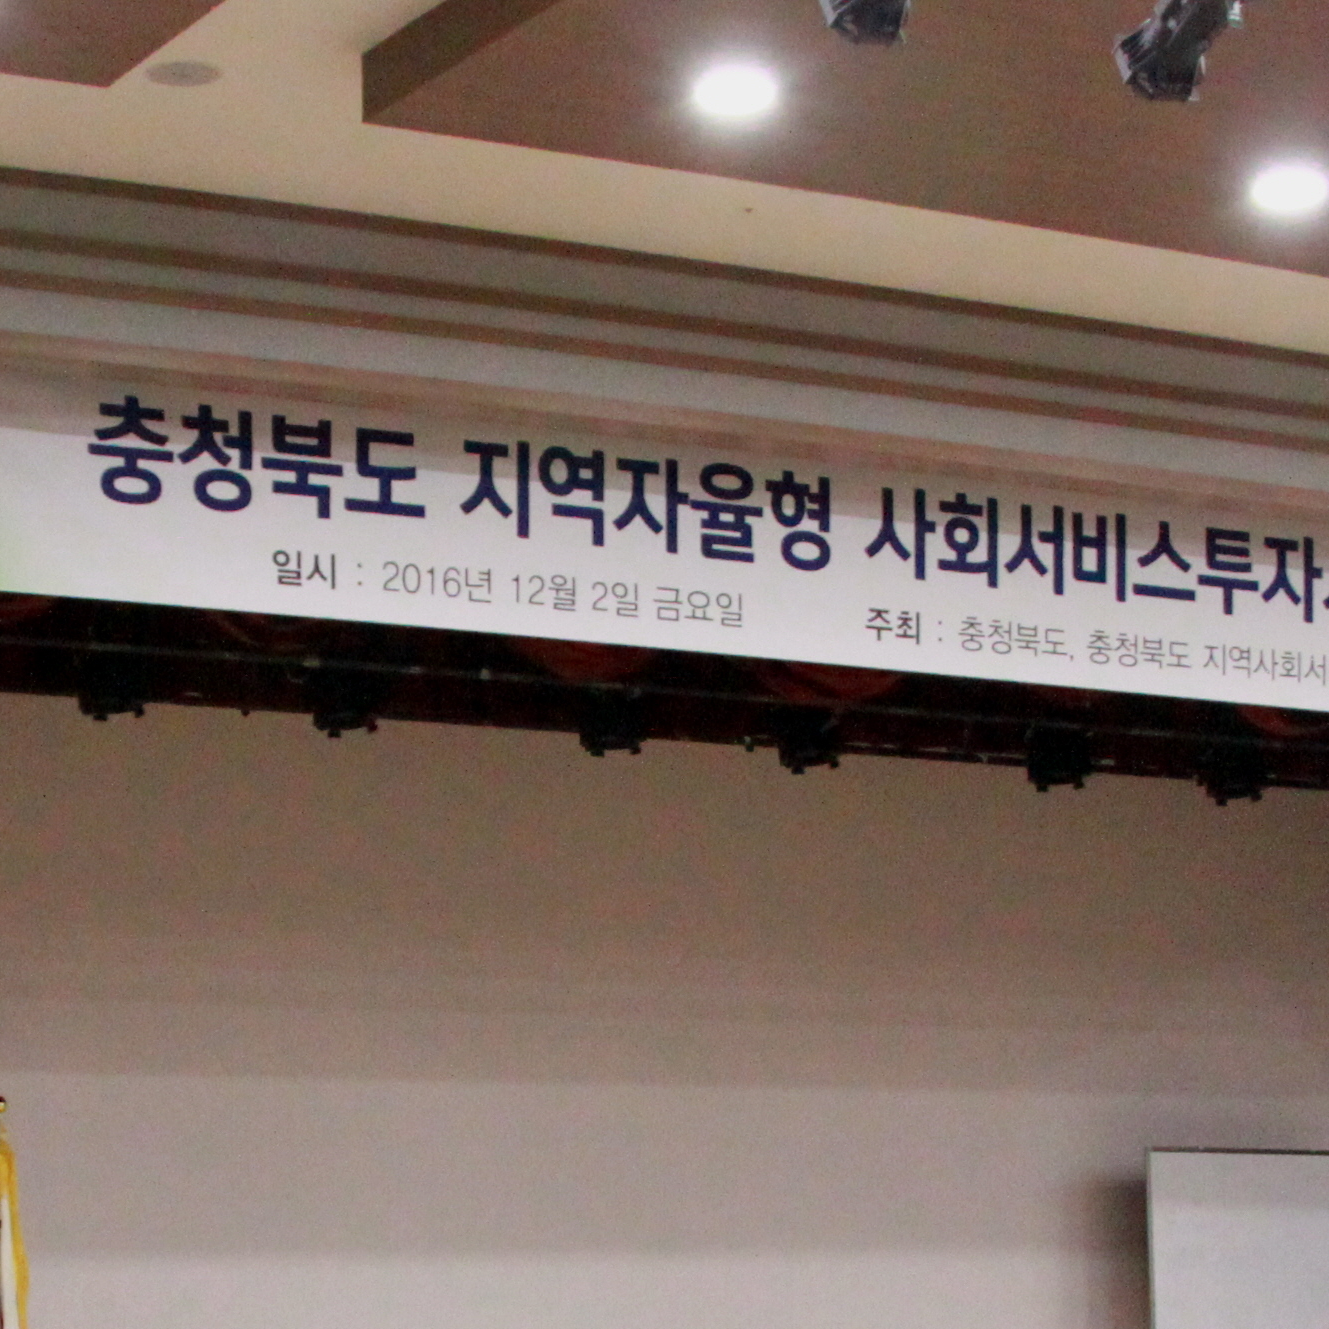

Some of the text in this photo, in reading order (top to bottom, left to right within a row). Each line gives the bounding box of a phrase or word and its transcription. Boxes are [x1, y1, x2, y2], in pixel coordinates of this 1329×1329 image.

[87, 395, 426, 518] 충청북도
[460, 439, 833, 571] 지역자율형
[271, 549, 337, 590] 일시
[382, 560, 492, 605] 2016년
[512, 573, 577, 612] 12월
[591, 581, 639, 618] 2일
[653, 586, 744, 628] 금요일
[865, 607, 921, 645] 주최
[958, 615, 1075, 662] 충청북도,
[1087, 629, 1192, 669] 충청북도
